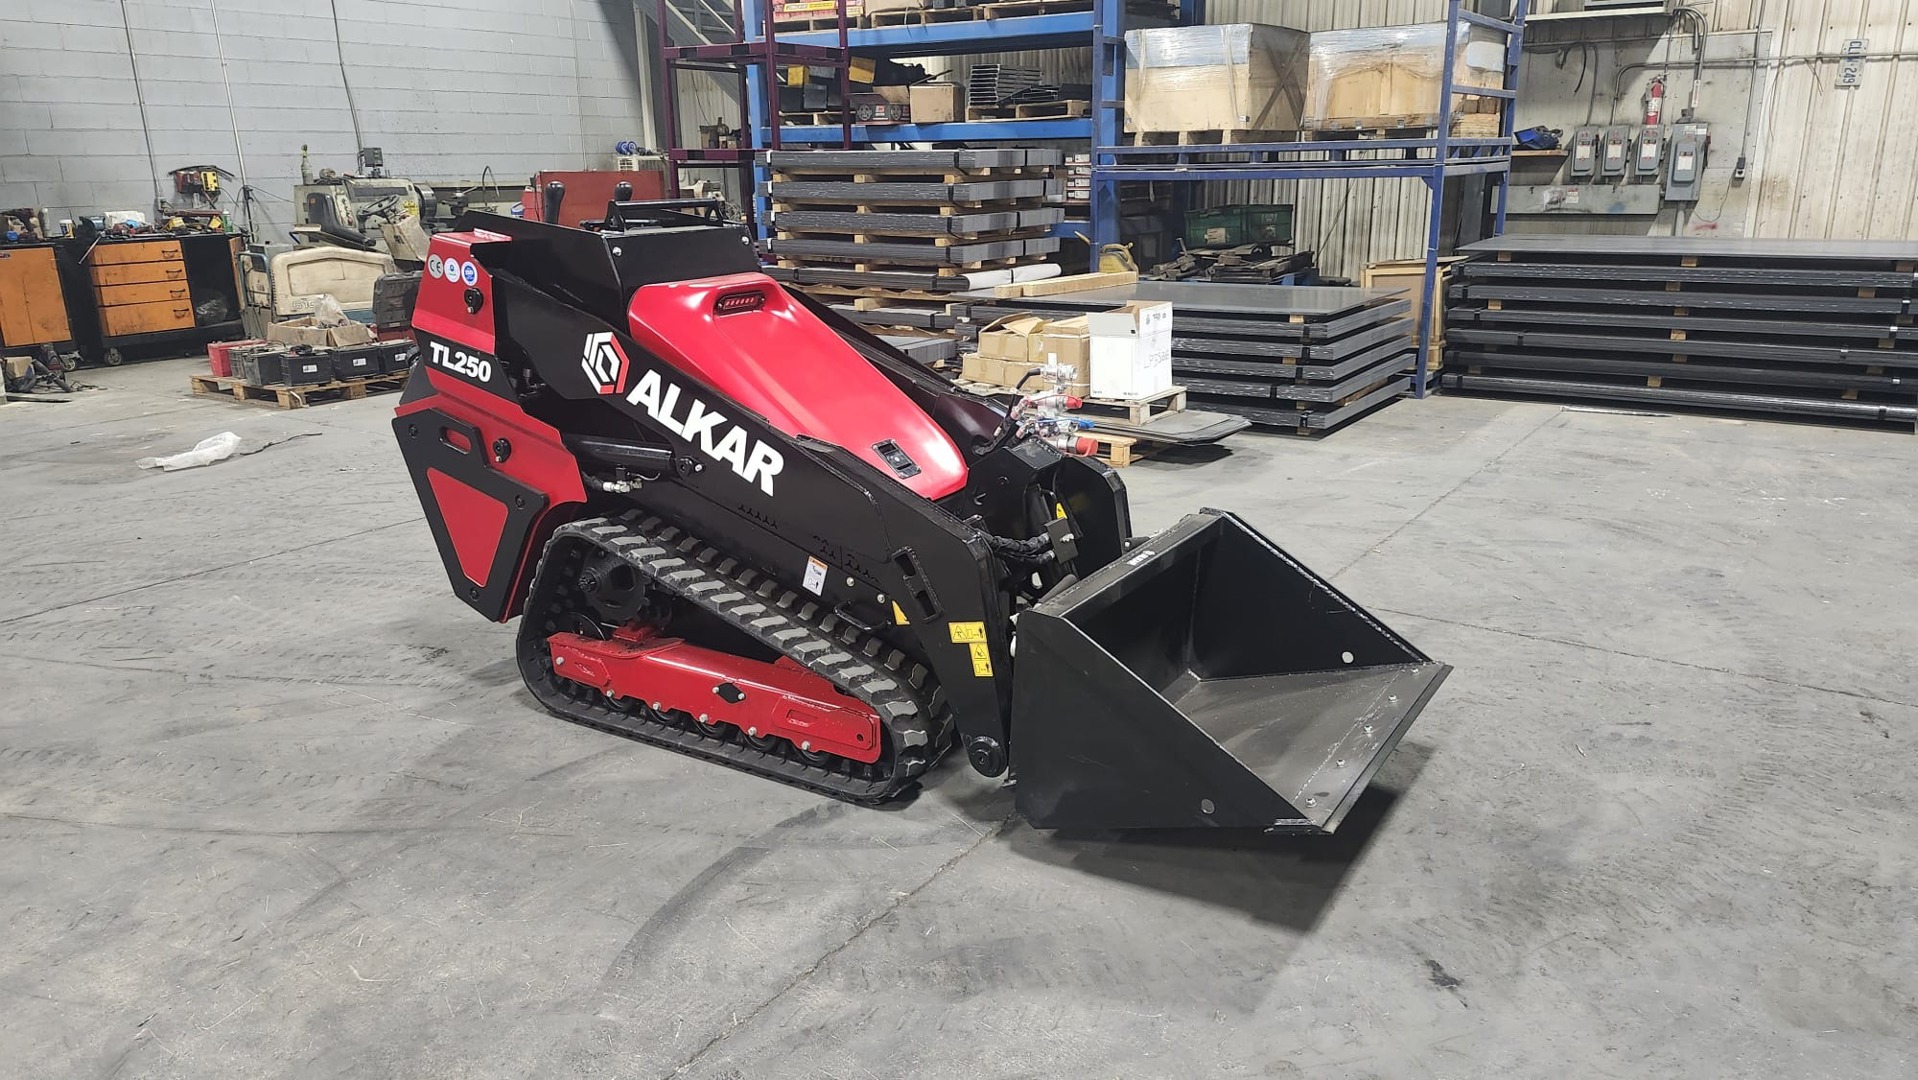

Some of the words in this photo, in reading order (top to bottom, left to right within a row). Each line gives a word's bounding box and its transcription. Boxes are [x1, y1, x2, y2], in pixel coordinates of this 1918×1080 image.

[1842, 67, 1857, 84] 249
[430, 341, 491, 382] TL250
[626, 370, 784, 496] ALKAR
